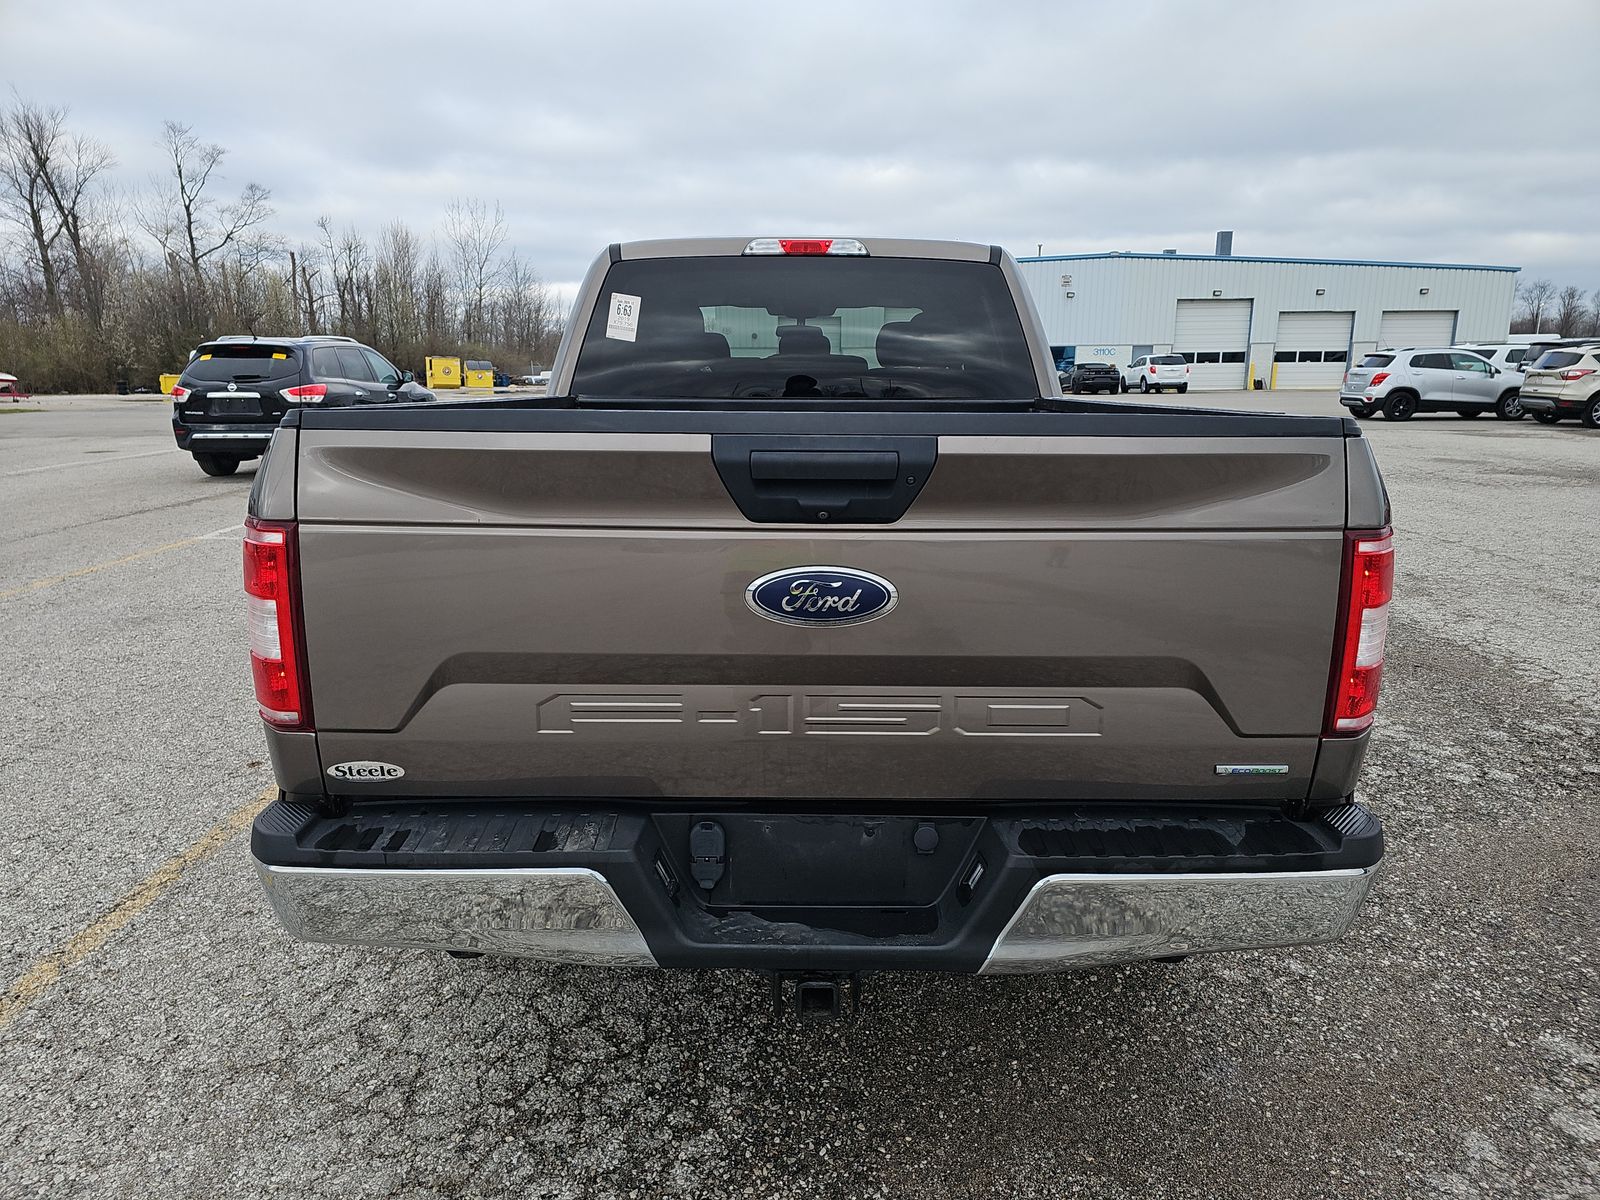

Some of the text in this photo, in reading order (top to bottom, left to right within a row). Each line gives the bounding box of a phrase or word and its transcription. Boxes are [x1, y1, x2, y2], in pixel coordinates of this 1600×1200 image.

[1093, 348, 1116, 356] 3110C
[781, 579, 861, 612] Ford
[535, 694, 1104, 738] F-150
[334, 765, 398, 777] Steele
